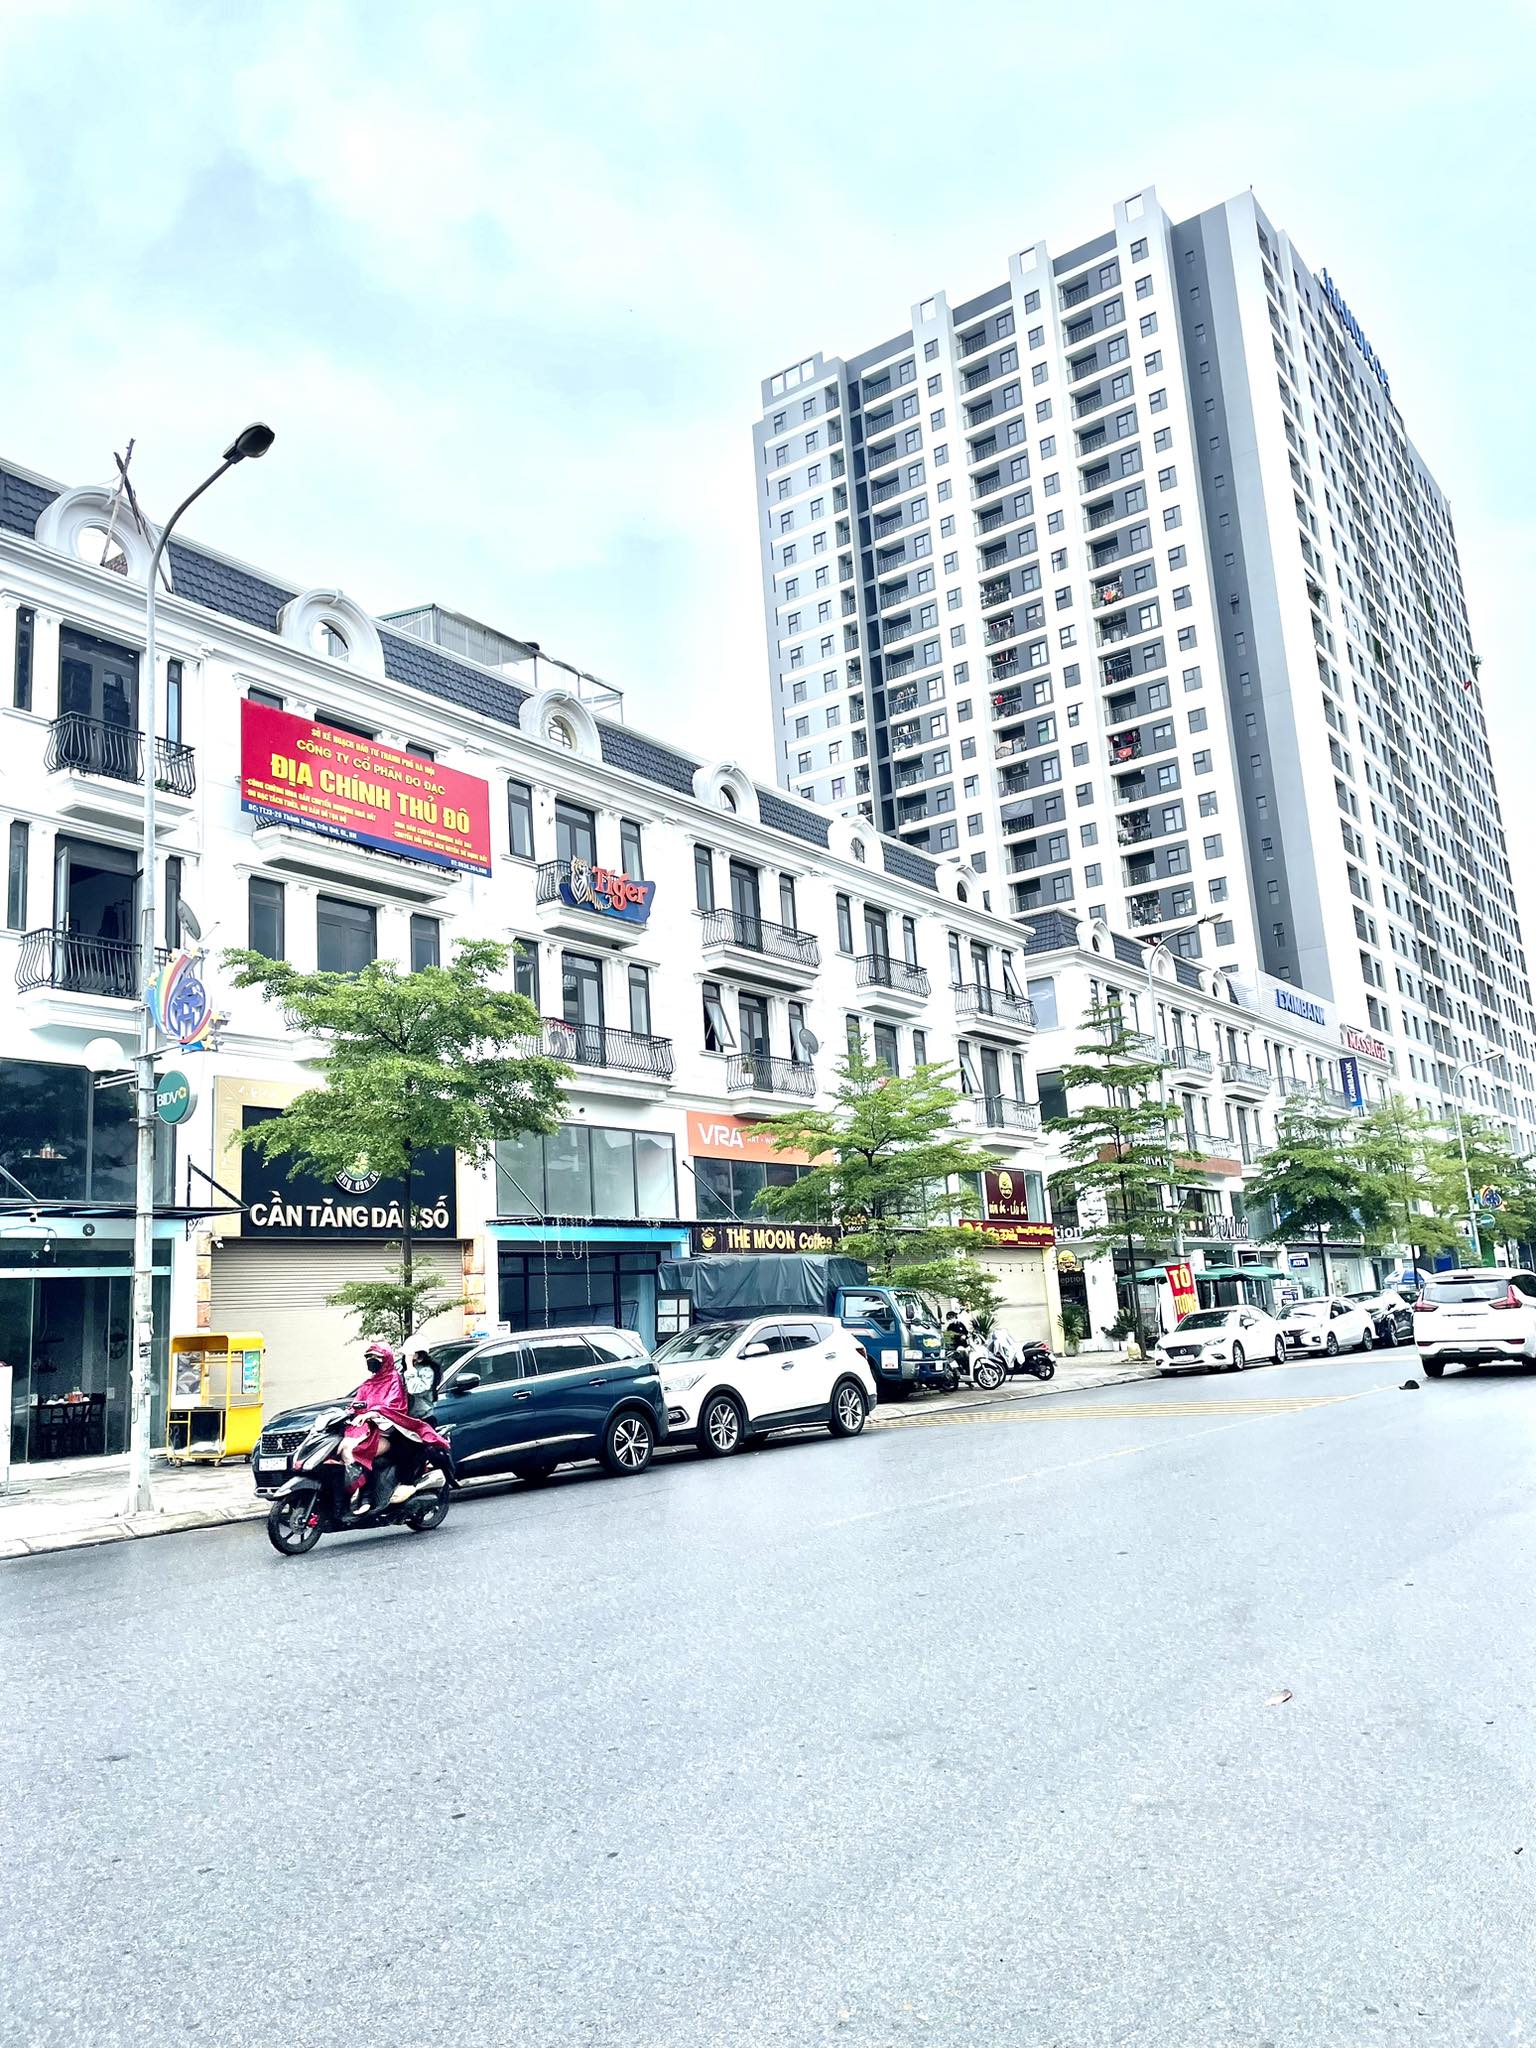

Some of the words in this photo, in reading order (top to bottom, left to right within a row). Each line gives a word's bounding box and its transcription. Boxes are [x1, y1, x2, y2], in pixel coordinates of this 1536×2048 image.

[296, 739, 332, 759] CÔNG
[336, 752, 349, 764] TY
[352, 755, 371, 771] CỔ
[373, 765, 402, 781] PHẦN
[405, 774, 421, 787] ĐO
[423, 781, 445, 795] ĐẠC
[270, 753, 314, 788] ĐỊA
[319, 770, 391, 811] CHÍNH
[396, 792, 438, 825] THỦ
[443, 807, 470, 834] ĐÔ
[592, 865, 648, 911] Tiger
[1347, 1030, 1387, 1062] MASSAGE
[156, 1091, 178, 1108] BIDV
[697, 1123, 744, 1149] VRA
[251, 1190, 302, 1228] CẦN
[306, 1197, 368, 1228] TĂNG
[420, 1195, 449, 1229] SỐ
[726, 1228, 750, 1249] THE
[753, 1229, 796, 1249] MOON
[799, 1232, 833, 1250] Coffee
[1169, 1264, 1191, 1289] TÔ
